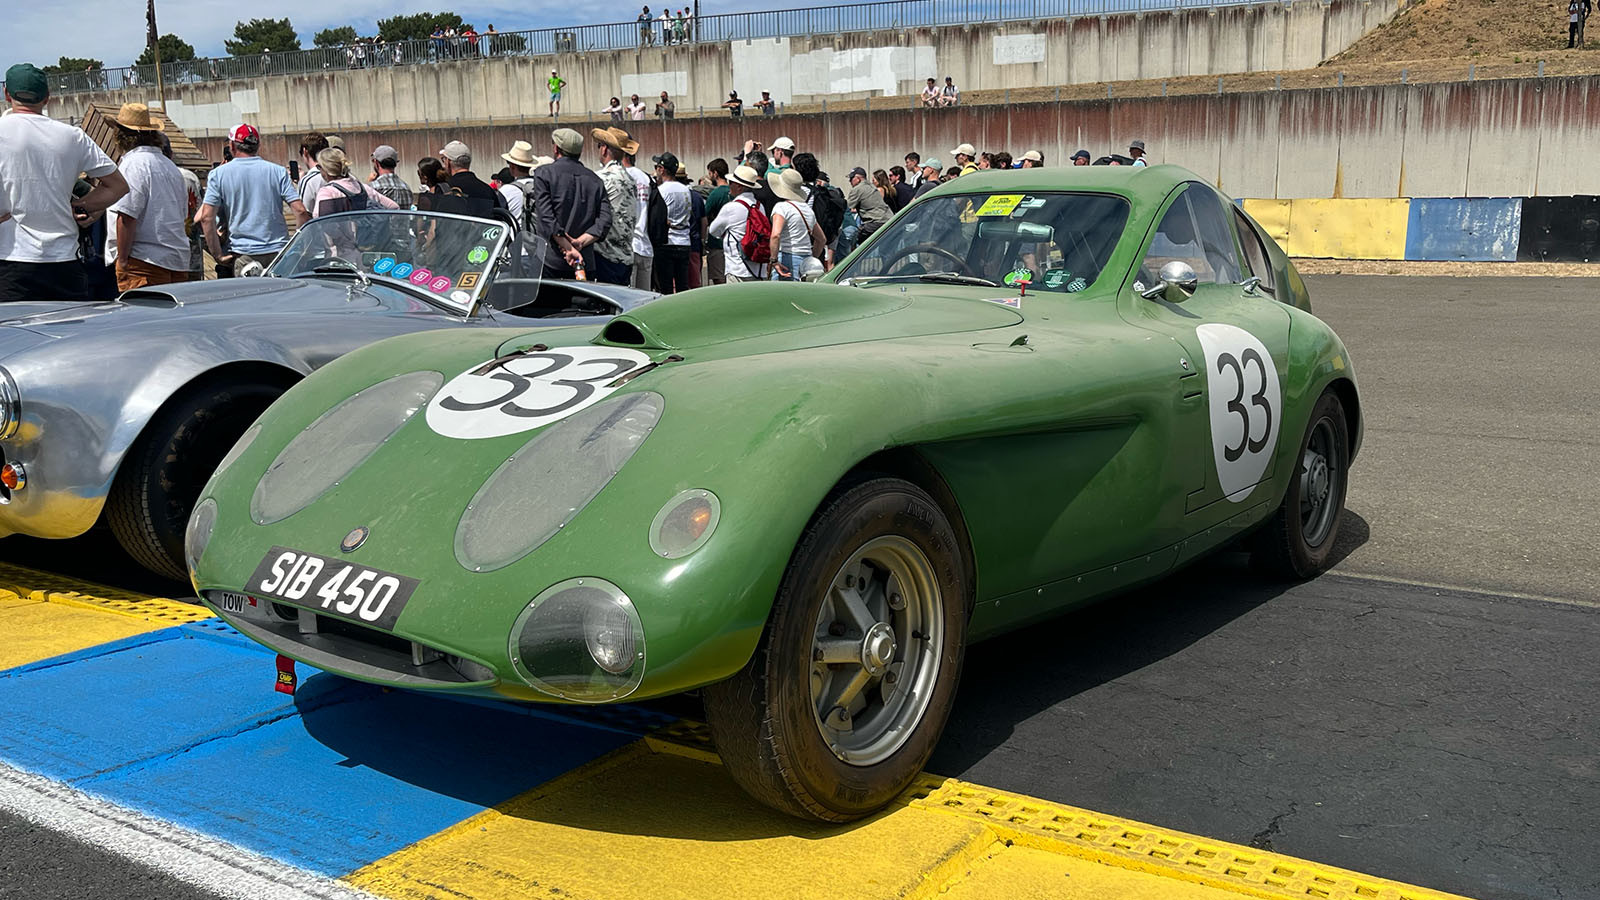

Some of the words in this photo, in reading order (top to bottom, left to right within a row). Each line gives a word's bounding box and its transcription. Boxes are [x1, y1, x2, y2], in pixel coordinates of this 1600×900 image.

[463, 276, 474, 285] S
[439, 352, 638, 418] 33
[1216, 347, 1272, 462] 33
[223, 593, 243, 612] TOW
[260, 551, 325, 600] SIB
[317, 565, 401, 622] 450
